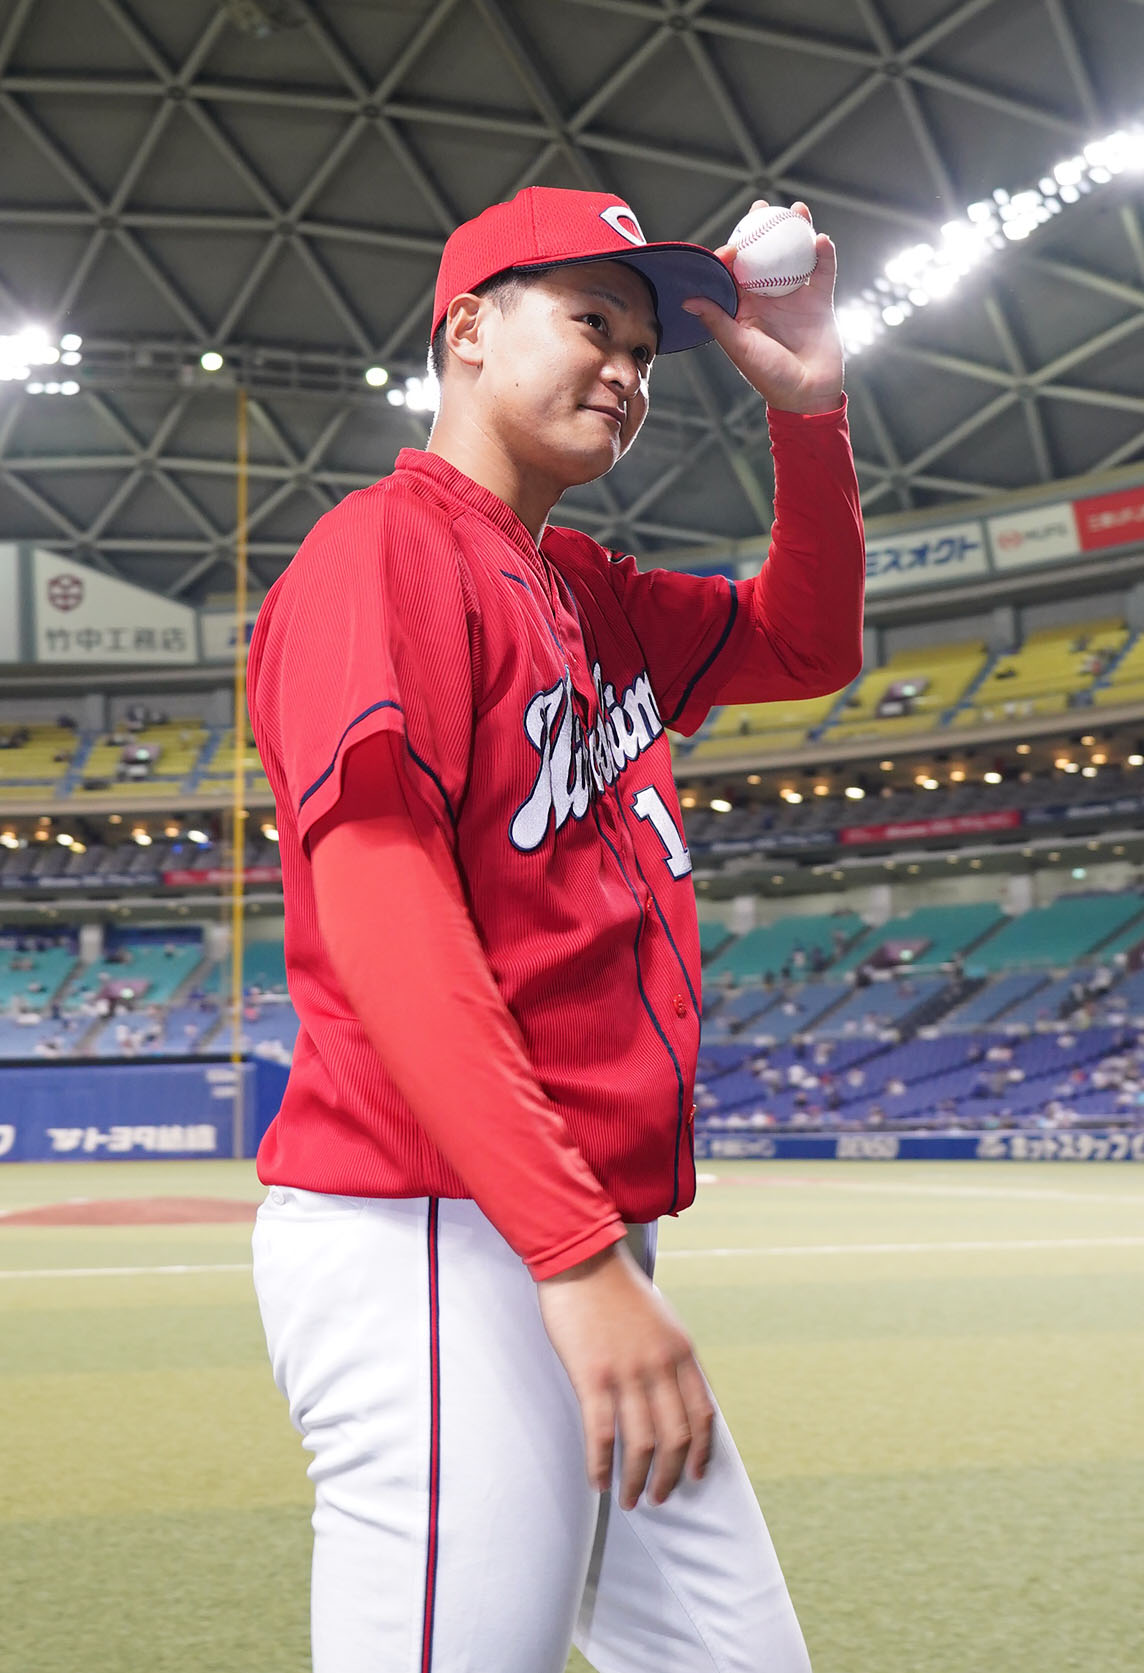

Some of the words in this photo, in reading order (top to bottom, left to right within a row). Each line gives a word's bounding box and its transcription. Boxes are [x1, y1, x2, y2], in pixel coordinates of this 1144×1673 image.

[46, 625, 188, 652] 竹中工務店
